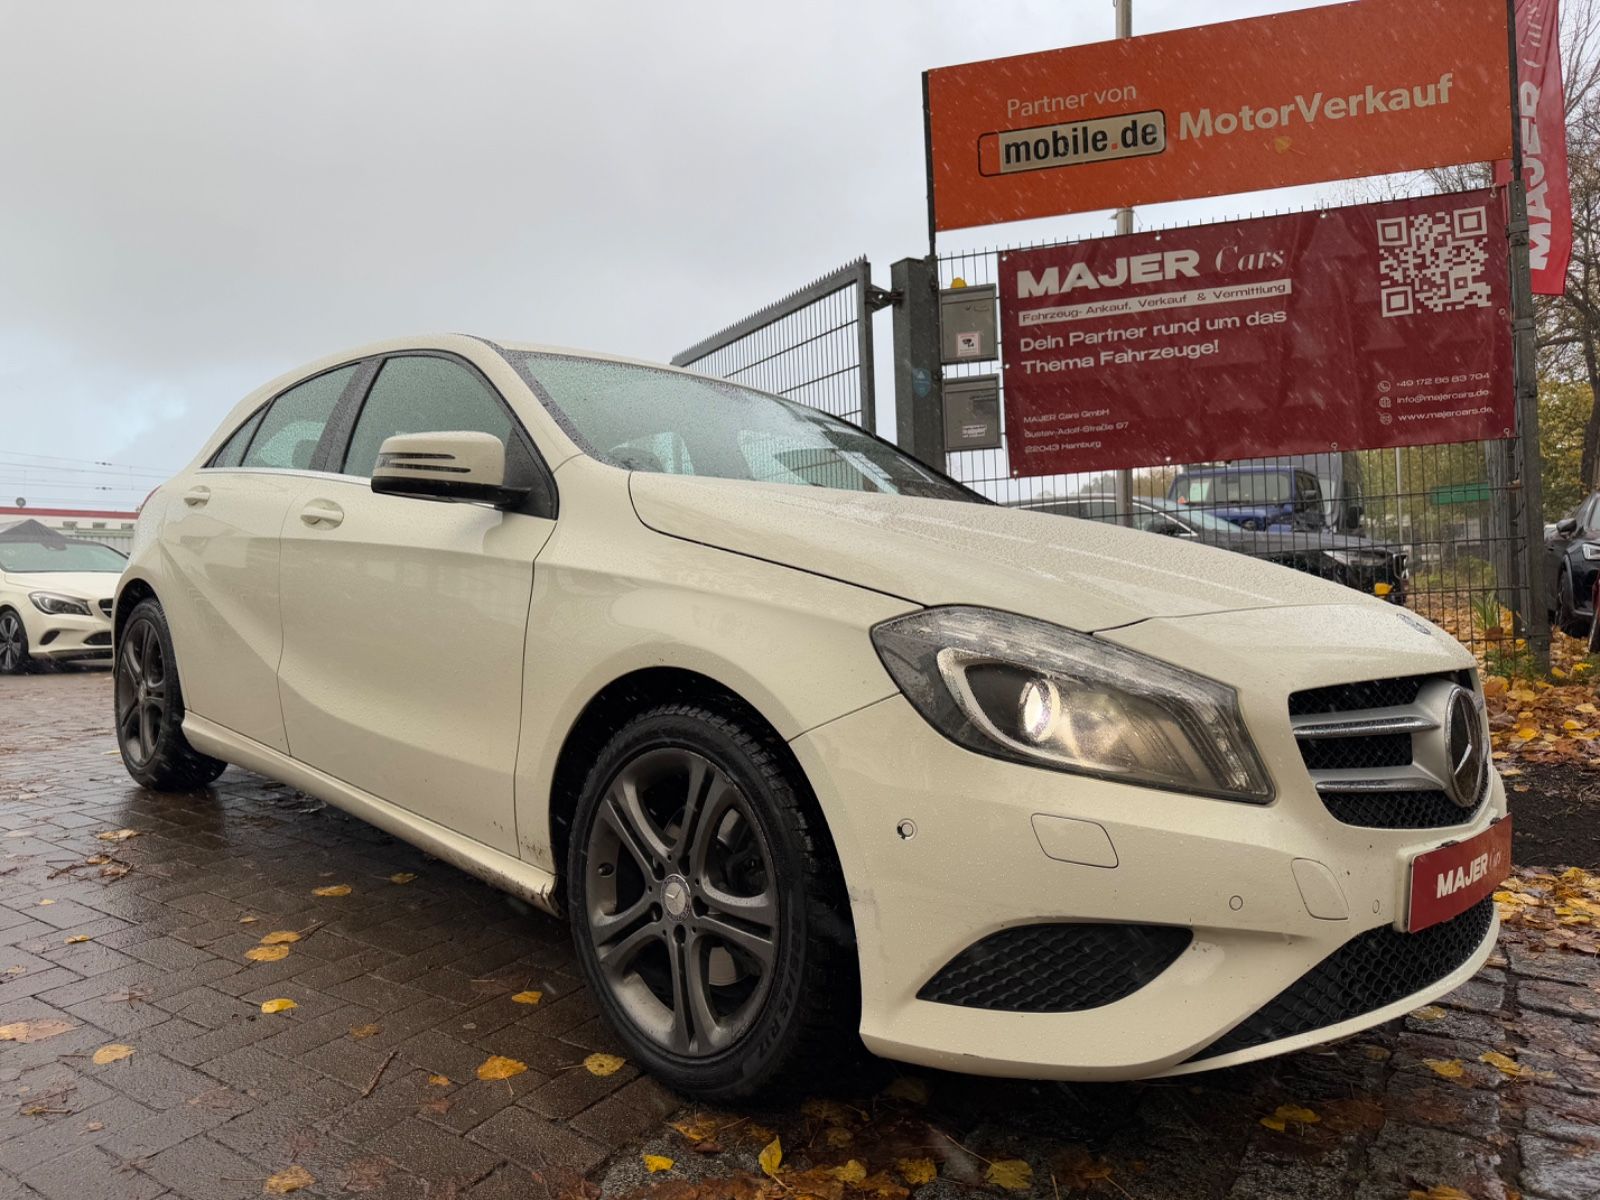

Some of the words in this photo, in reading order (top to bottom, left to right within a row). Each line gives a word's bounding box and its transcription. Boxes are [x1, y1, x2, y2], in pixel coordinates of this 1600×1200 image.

[1007, 92, 1089, 119] Partner
[1093, 85, 1137, 105] von
[1179, 73, 1453, 141] MotorVerkauf
[1004, 119, 1158, 164] mobile.de
[1520, 81, 1551, 270] MAJER
[1017, 249, 1201, 299] MAJER
[1215, 245, 1285, 274] Cars
[1137, 294, 1187, 309] Verkauf
[1196, 291, 1206, 302] &
[1212, 281, 1286, 300] Vermittlung
[1020, 336, 1064, 353] Dein
[1069, 326, 1148, 348] Partner
[1153, 317, 1200, 337] rund
[1206, 315, 1241, 332] um
[1246, 310, 1287, 327] das
[1021, 355, 1095, 375] Thema
[1100, 339, 1220, 367] Fahrzeuge!
[1024, 414, 1056, 424] MAJER
[1058, 411, 1080, 421] Cars
[1081, 408, 1110, 419] GmbH
[1396, 389, 1490, 404] info@majercars.de
[1436, 853, 1488, 899] MAJER
